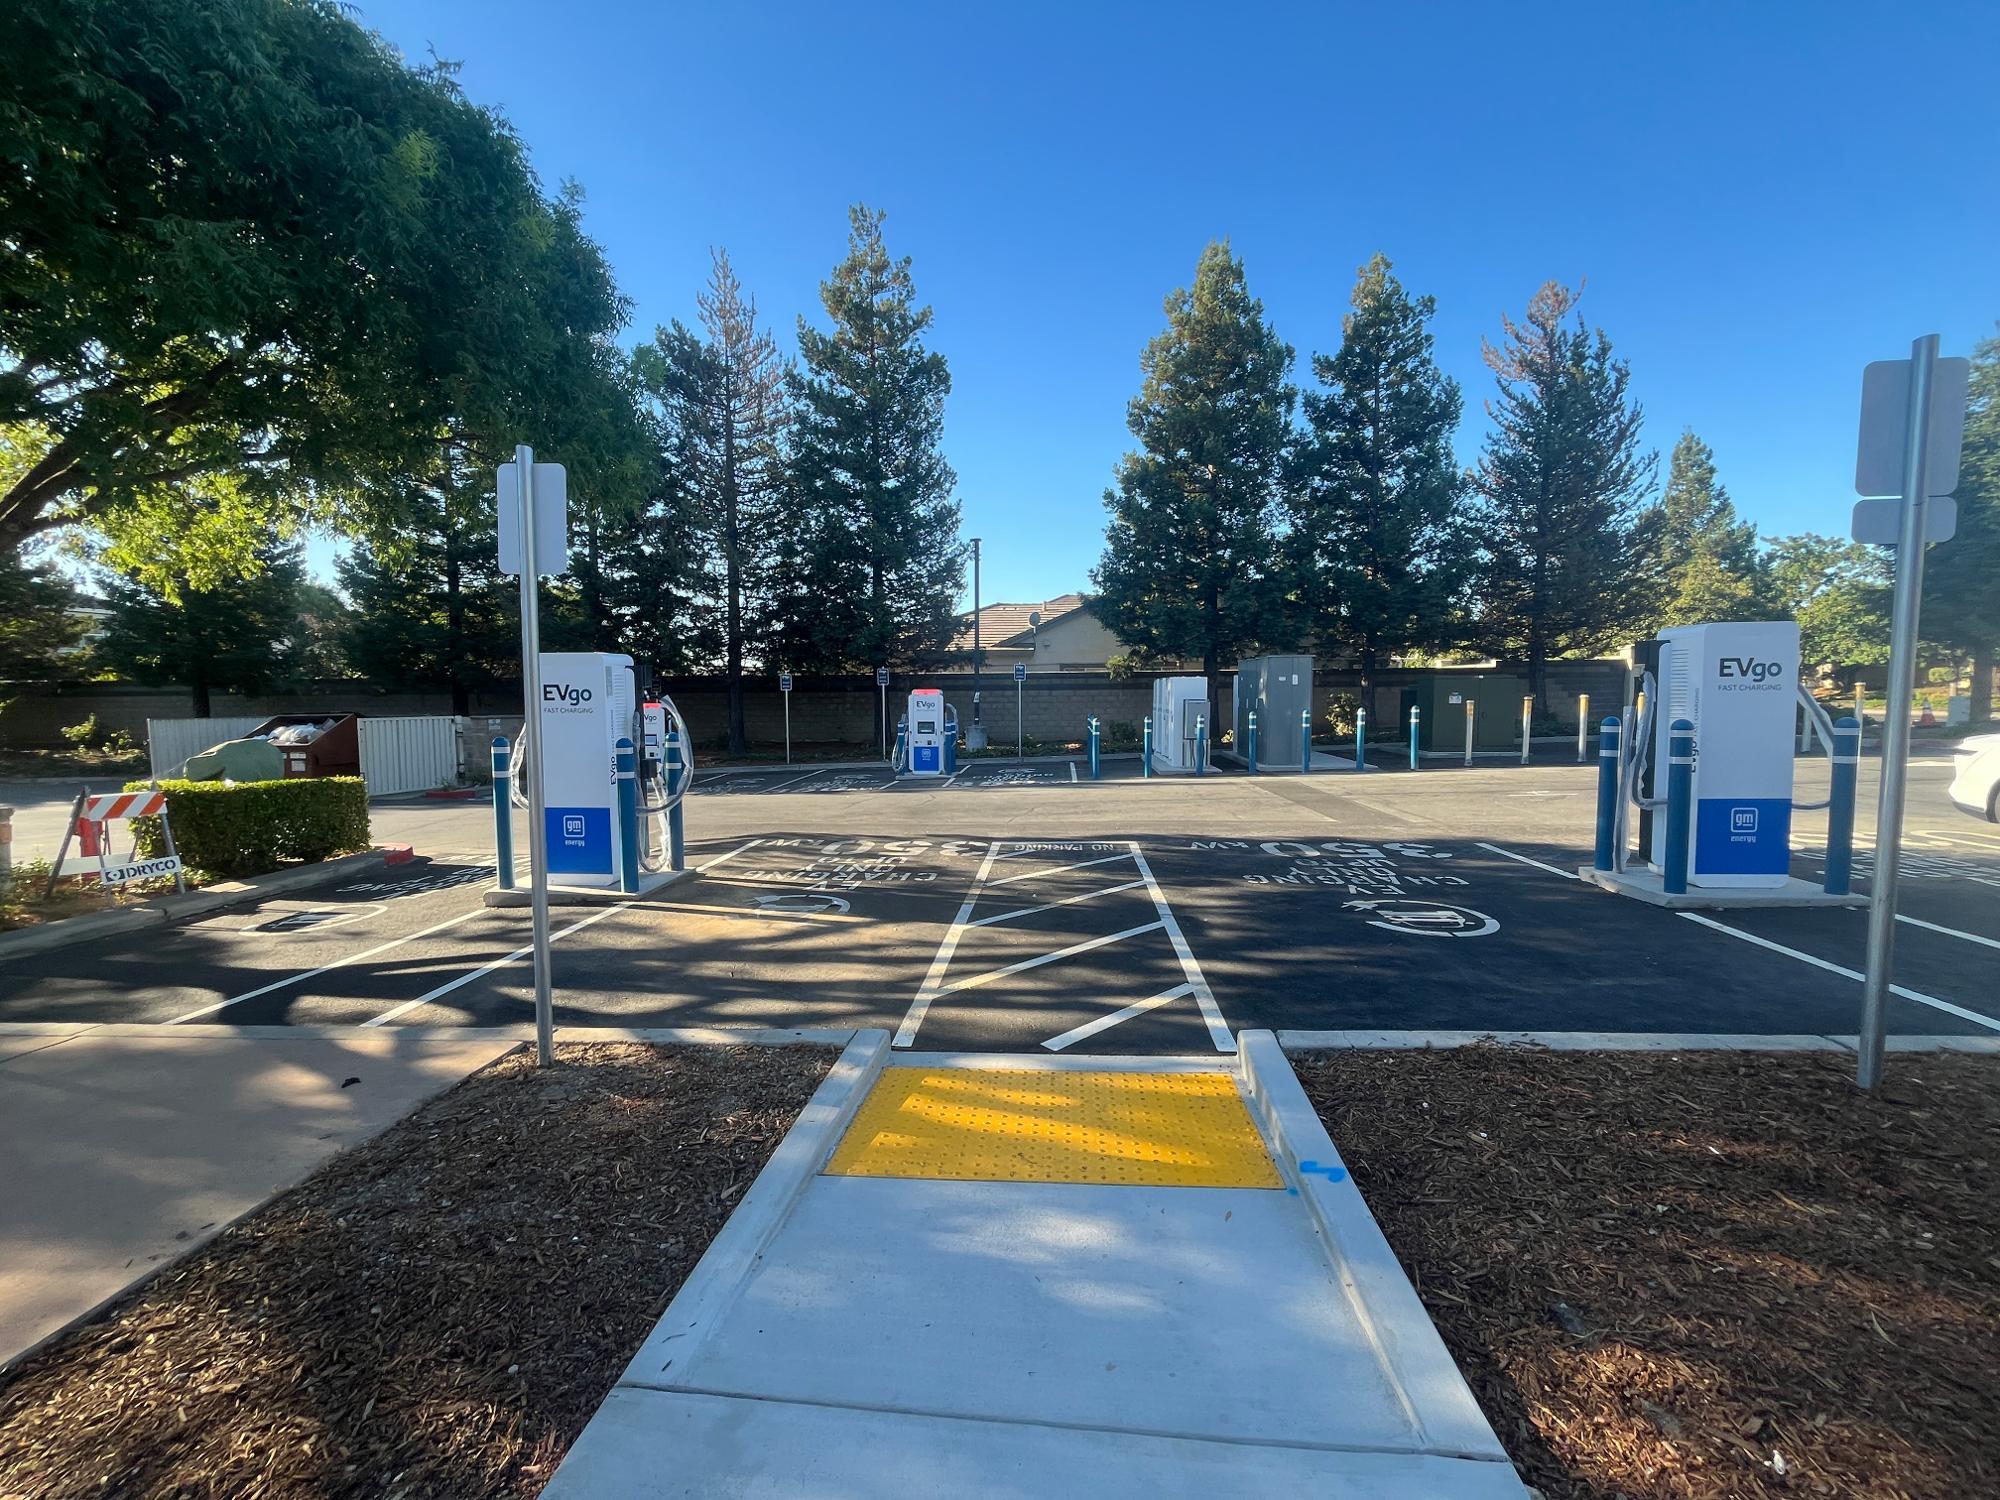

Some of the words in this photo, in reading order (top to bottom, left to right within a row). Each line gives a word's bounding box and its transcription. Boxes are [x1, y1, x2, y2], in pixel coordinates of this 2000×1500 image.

[1719, 657, 1782, 682] EVgo
[543, 684, 592, 706] EVgo
[916, 700, 936, 709] EVgo
[644, 714, 658, 723] Vgo
[567, 819, 581, 832] gm
[1736, 813, 1754, 827] gm
[564, 839, 585, 847] energy
[1730, 835, 1757, 843] energy
[820, 840, 989, 857] 350
[1260, 842, 1454, 858] 350
[126, 859, 176, 878] DRYCO
[796, 863, 897, 873] ONLY
[1288, 866, 1397, 876] ONLY
[743, 870, 938, 882] CHARGING
[1243, 874, 1471, 885] CHARGING
[803, 880, 863, 891] EV
[1347, 884, 1407, 895] EV
